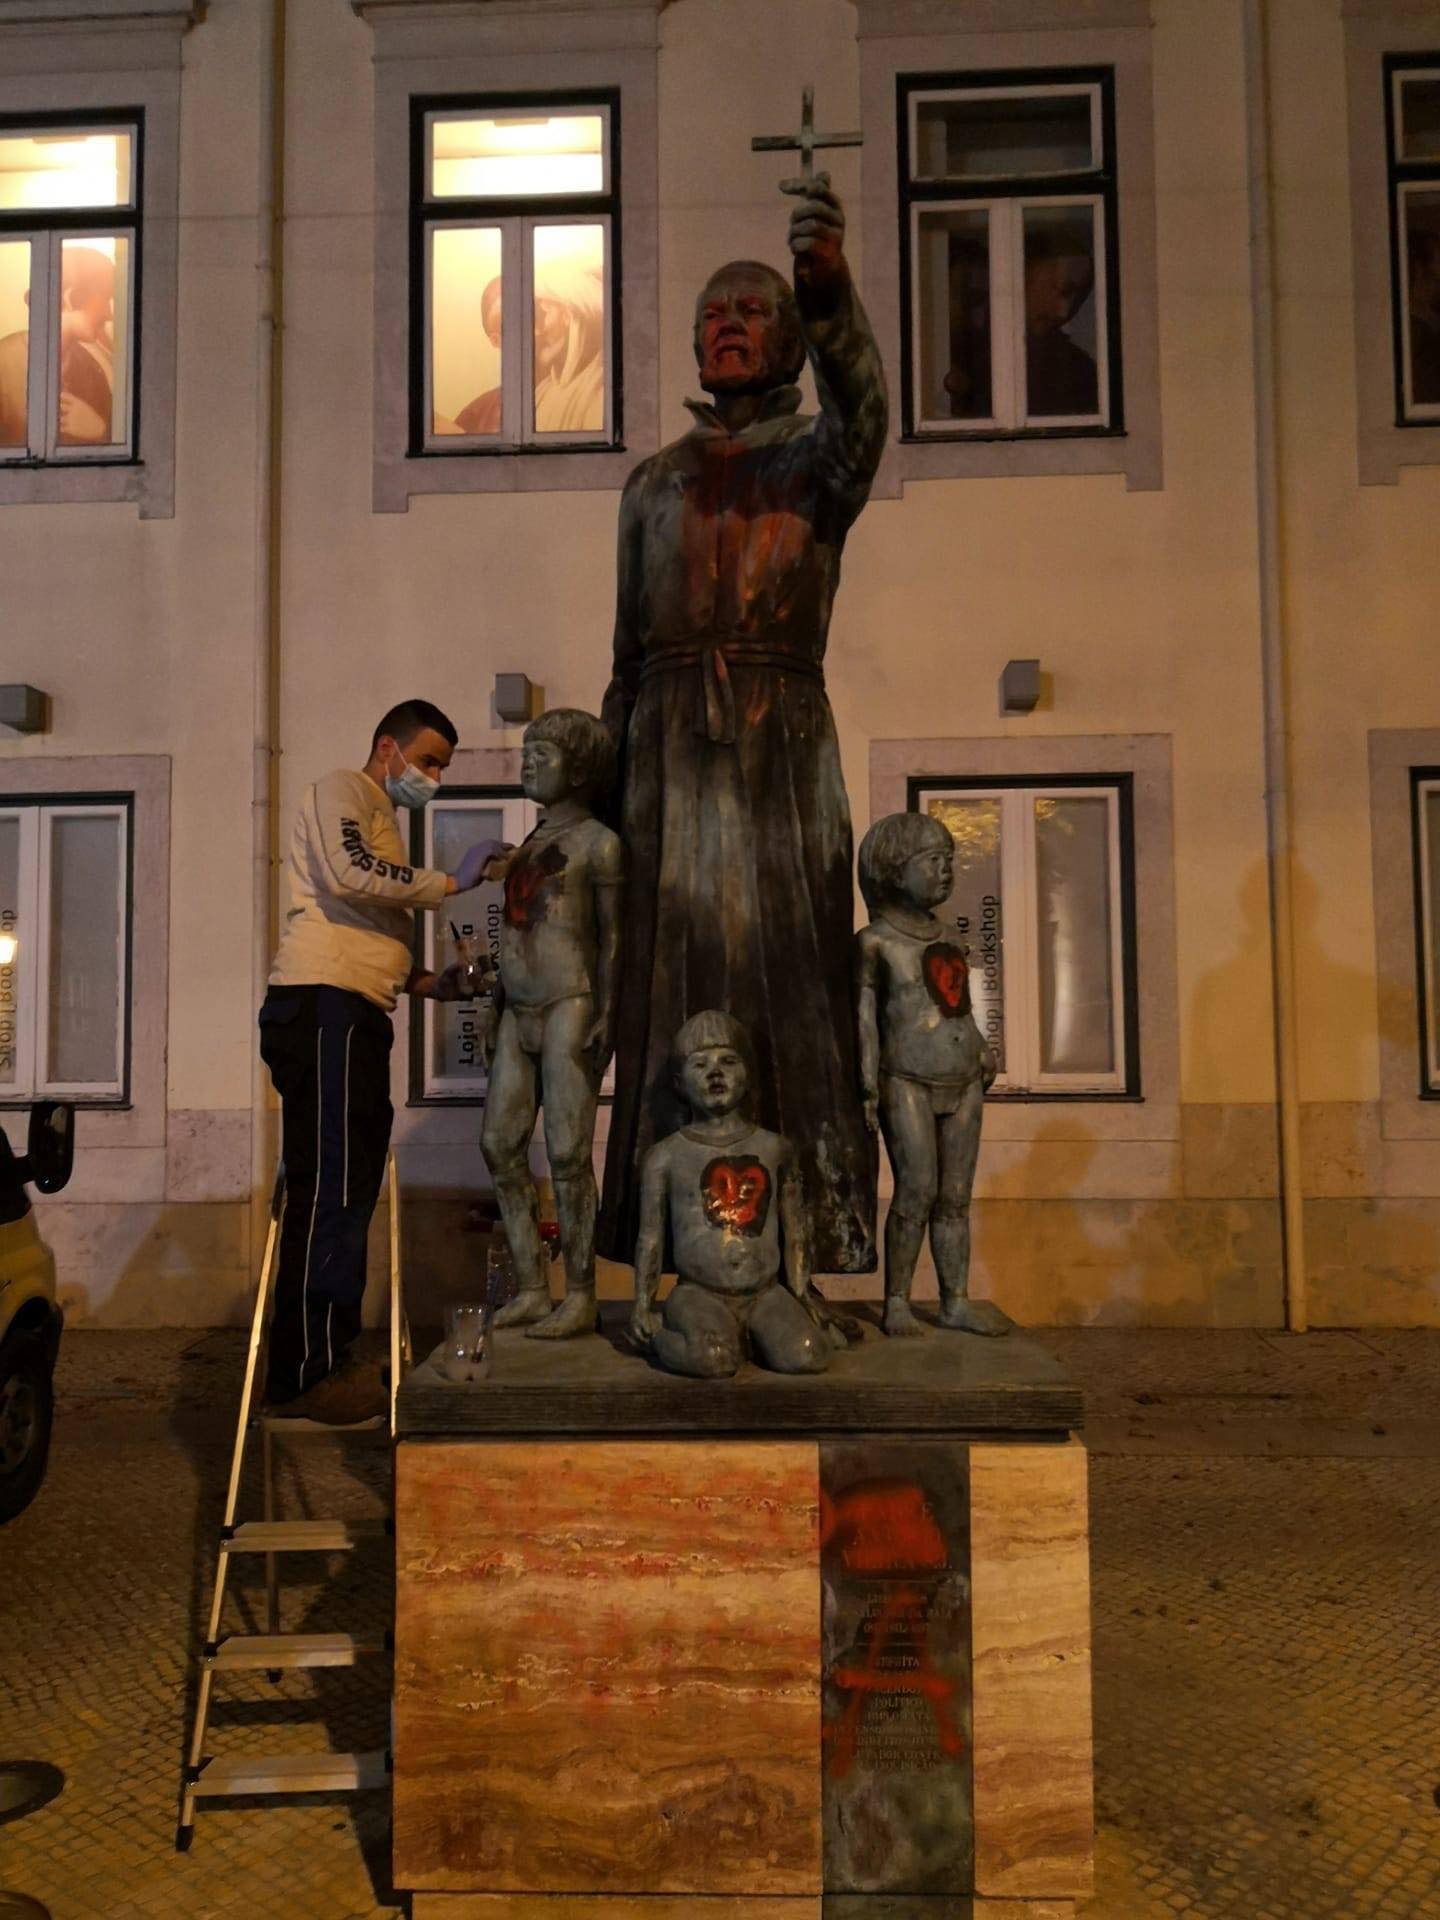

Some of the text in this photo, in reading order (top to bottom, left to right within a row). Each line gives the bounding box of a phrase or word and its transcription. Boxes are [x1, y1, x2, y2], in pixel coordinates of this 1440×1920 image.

[0, 908, 17, 1003] Booop
[979, 895, 1001, 991] Bookshop
[457, 1021, 478, 1065] Loja
